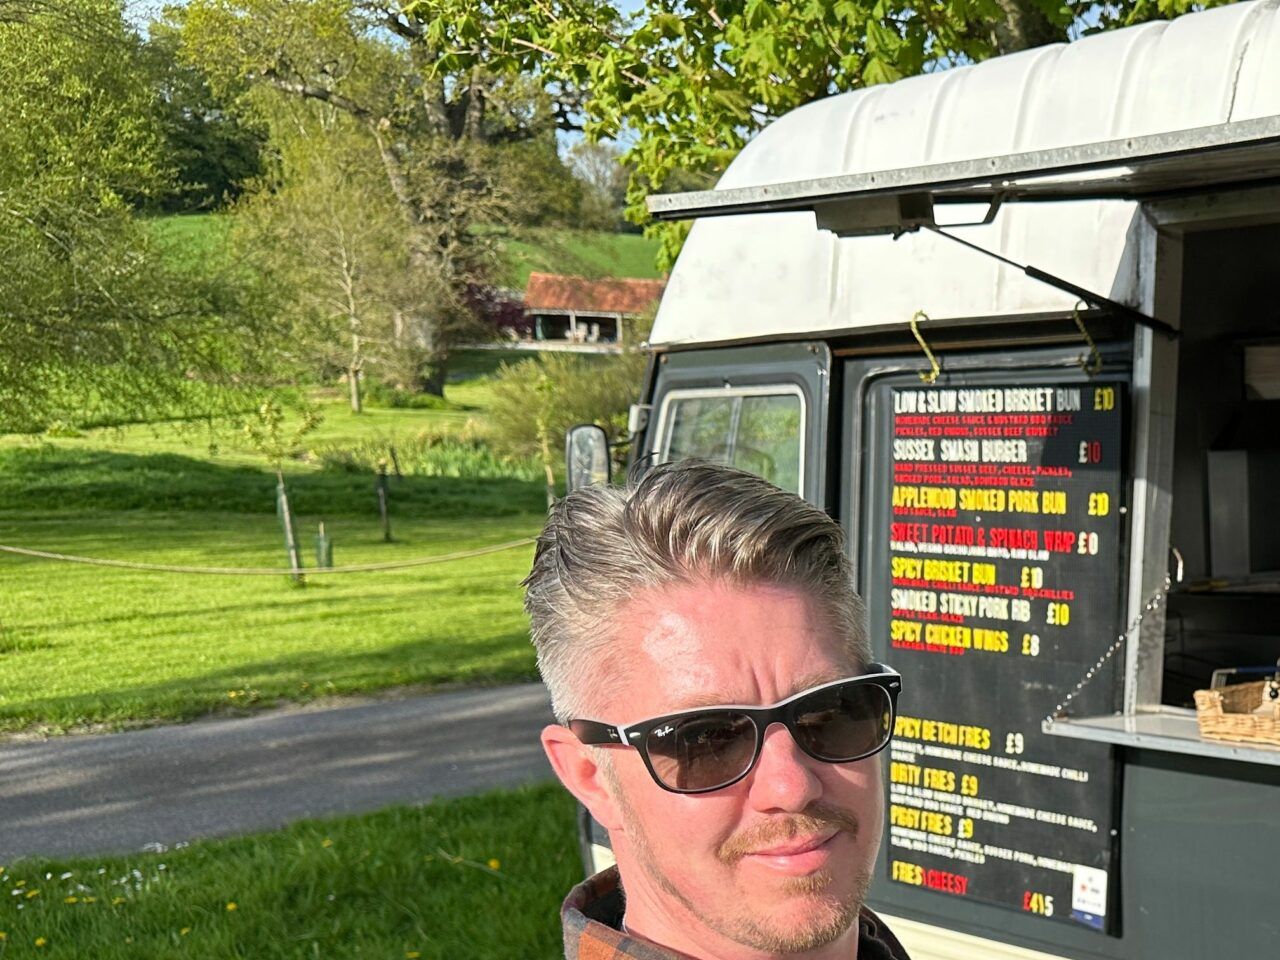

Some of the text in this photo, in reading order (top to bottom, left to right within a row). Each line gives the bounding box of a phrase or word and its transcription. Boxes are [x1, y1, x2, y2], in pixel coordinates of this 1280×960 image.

[927, 391, 957, 412] SLOW
[959, 389, 1004, 412] SMOKED
[1005, 389, 1052, 412] BRISKET
[1057, 389, 1080, 411] BUN
[1094, 387, 1114, 410] £10
[893, 439, 1101, 463] SUSSEX SMASH BURGER £10
[893, 486, 1109, 516] APPLEWOOD SMOKED PORK BUN £10
[891, 523, 928, 542] SWEET
[932, 525, 973, 544] POTATO
[977, 528, 985, 545] &
[990, 528, 1037, 549] SPINACH
[1044, 531, 1076, 553] WRAP
[891, 557, 1043, 589] SPICY BRISKET BUN £10
[891, 589, 1070, 626] SMOKED STICKY PORK RIB £10
[891, 621, 1040, 657] SPICY CHICKEN WINGS £8
[959, 725, 990, 750] FRIES
[1005, 732, 1024, 754] £9
[890, 762, 978, 797] DIRTY FRIES £9
[890, 805, 973, 839] PIGGY FRIES £9
